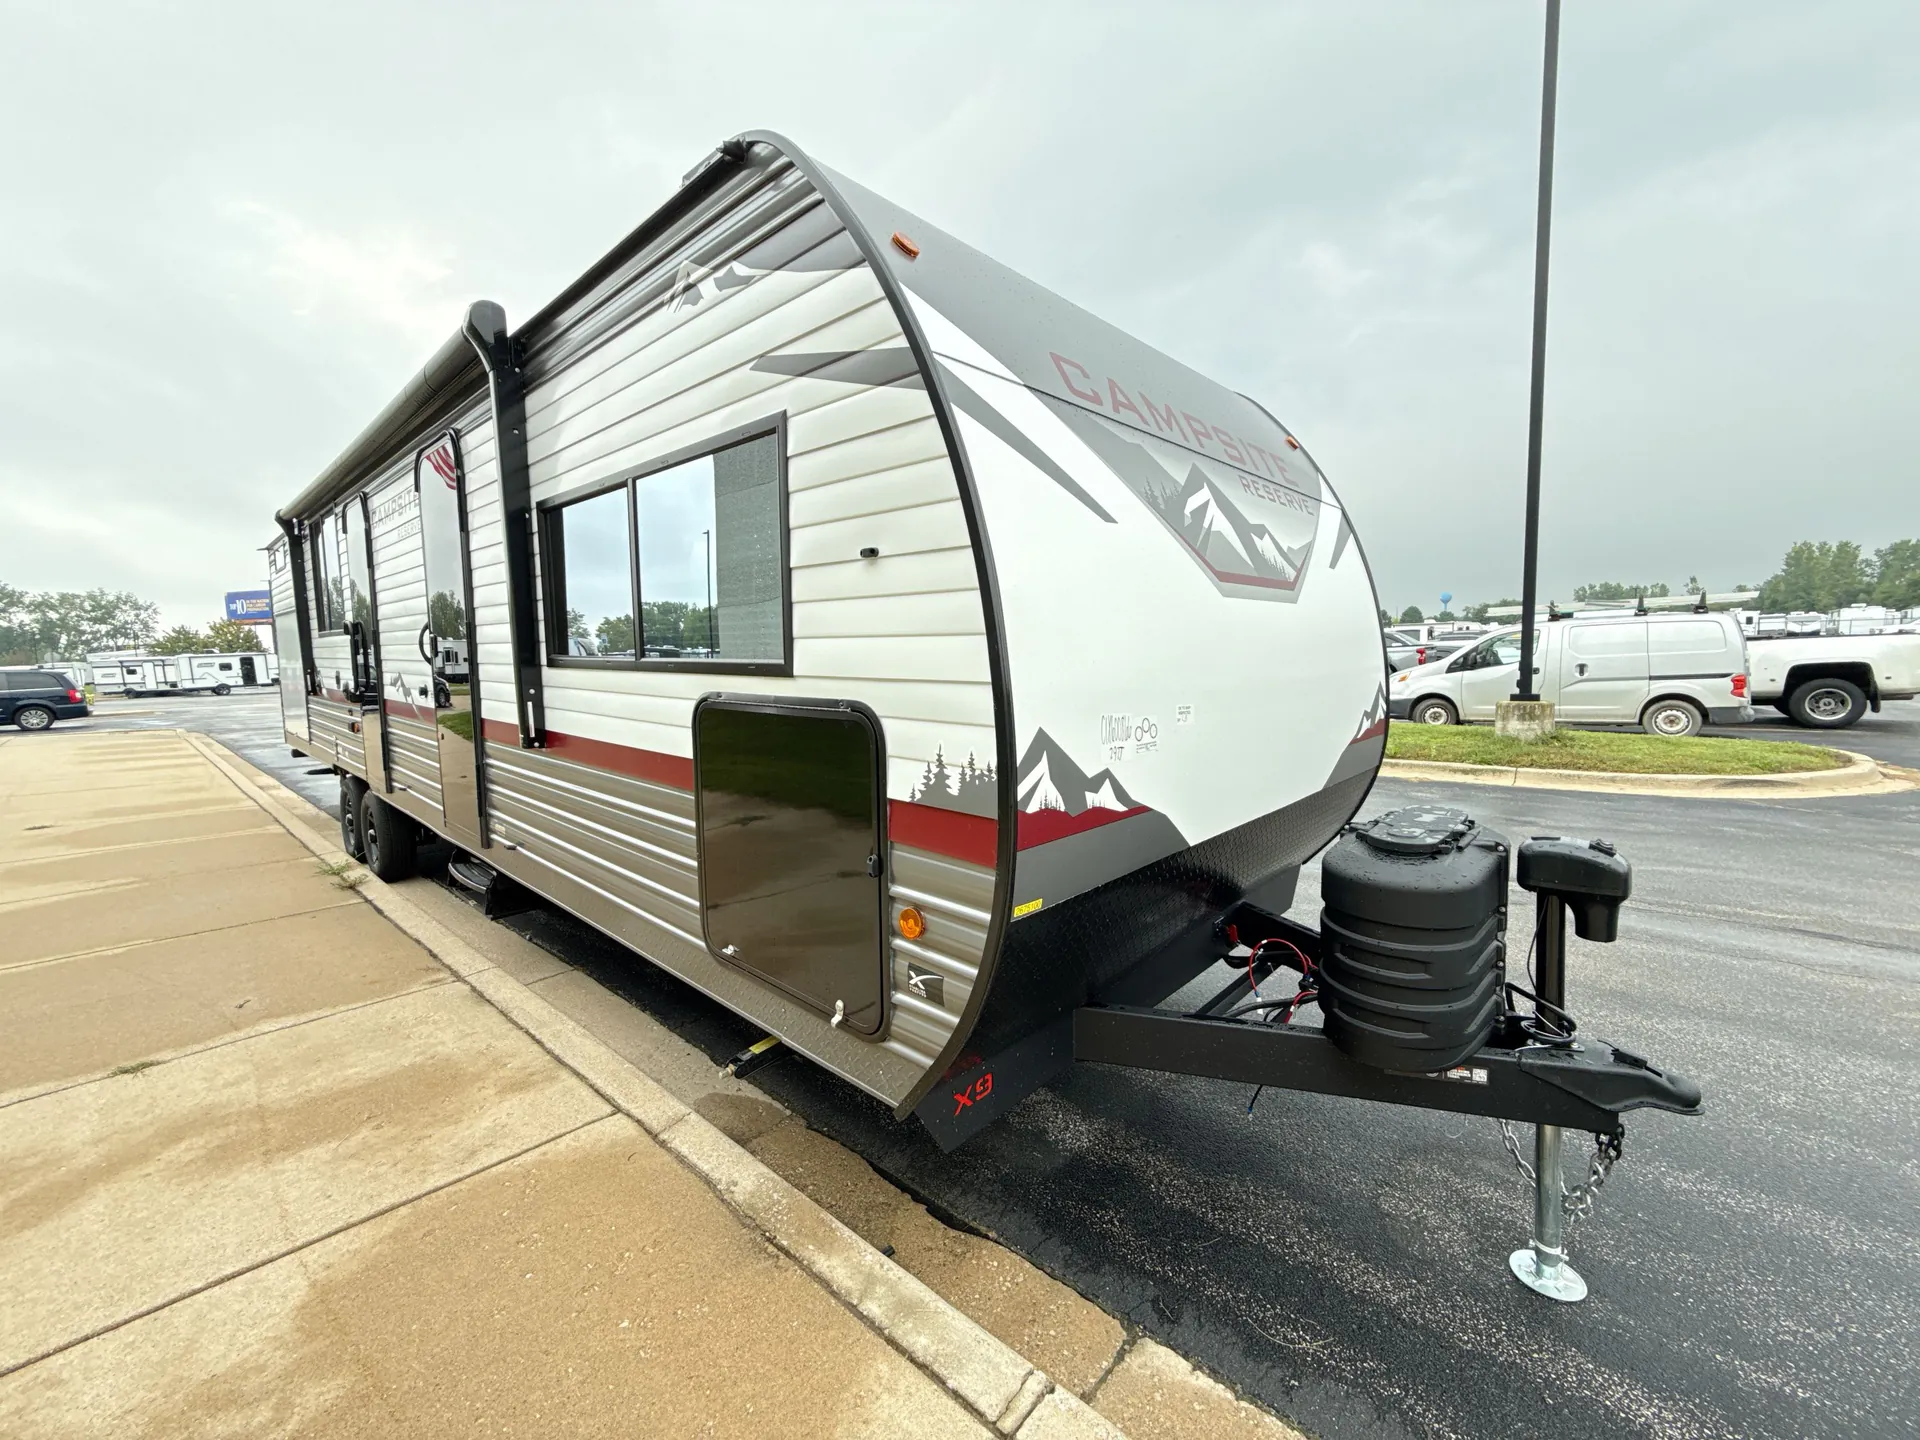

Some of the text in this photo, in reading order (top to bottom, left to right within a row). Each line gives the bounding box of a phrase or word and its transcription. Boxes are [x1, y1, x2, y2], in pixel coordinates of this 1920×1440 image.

[1050, 352, 1299, 488] CAMPSITE
[1238, 475, 1315, 516] RESERVE
[236, 599, 246, 614] 10
[953, 1072, 993, 1116] X9
